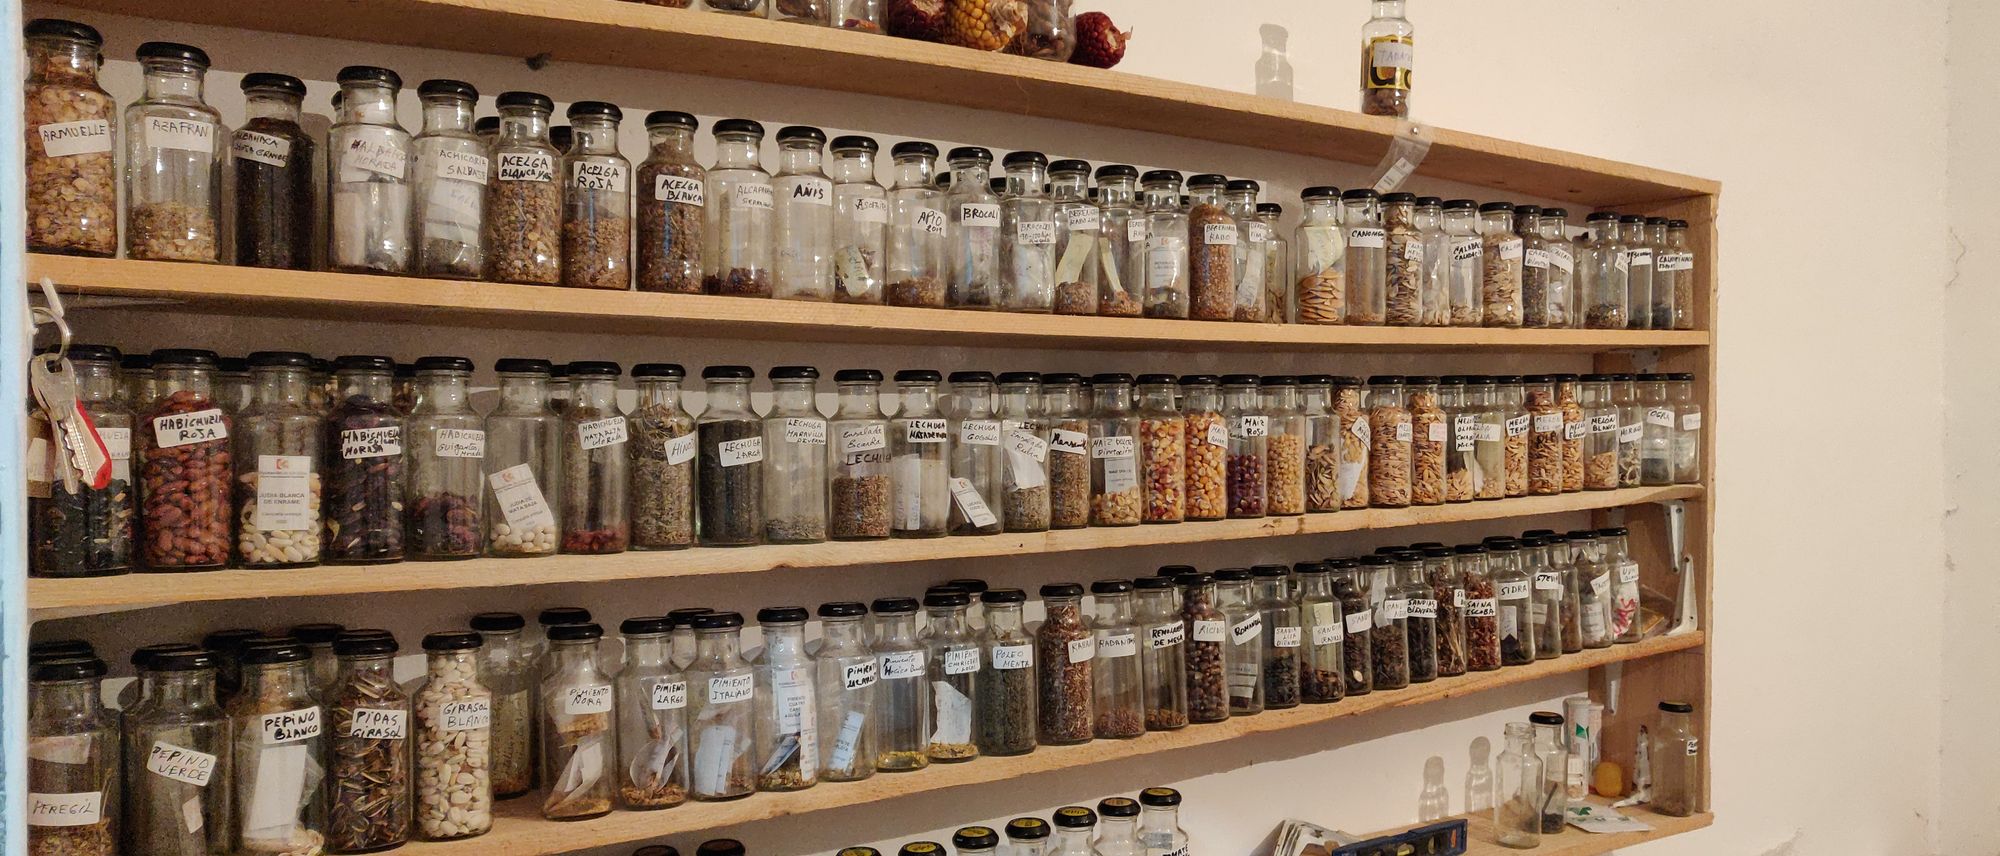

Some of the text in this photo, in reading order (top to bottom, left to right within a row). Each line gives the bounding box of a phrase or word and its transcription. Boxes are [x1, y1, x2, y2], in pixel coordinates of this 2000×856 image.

[43, 124, 106, 142] ARMUELLE
[502, 156, 549, 168] ACELGA
[579, 163, 619, 178] ACELGA
[662, 179, 699, 193] ACELGA
[667, 190, 703, 204] BLANCA
[918, 211, 942, 226] APIO
[787, 420, 822, 430] LECHUGA
[1501, 584, 1527, 596] SIDRA
[712, 675, 751, 689] PIMIENTO
[263, 711, 317, 732] PEPINO
[355, 710, 399, 729] PIPAS
[273, 723, 319, 741] BLANCO
[351, 726, 402, 739] GIRASOL
[151, 746, 210, 770] PEPINO
[158, 763, 207, 782] VERDE
